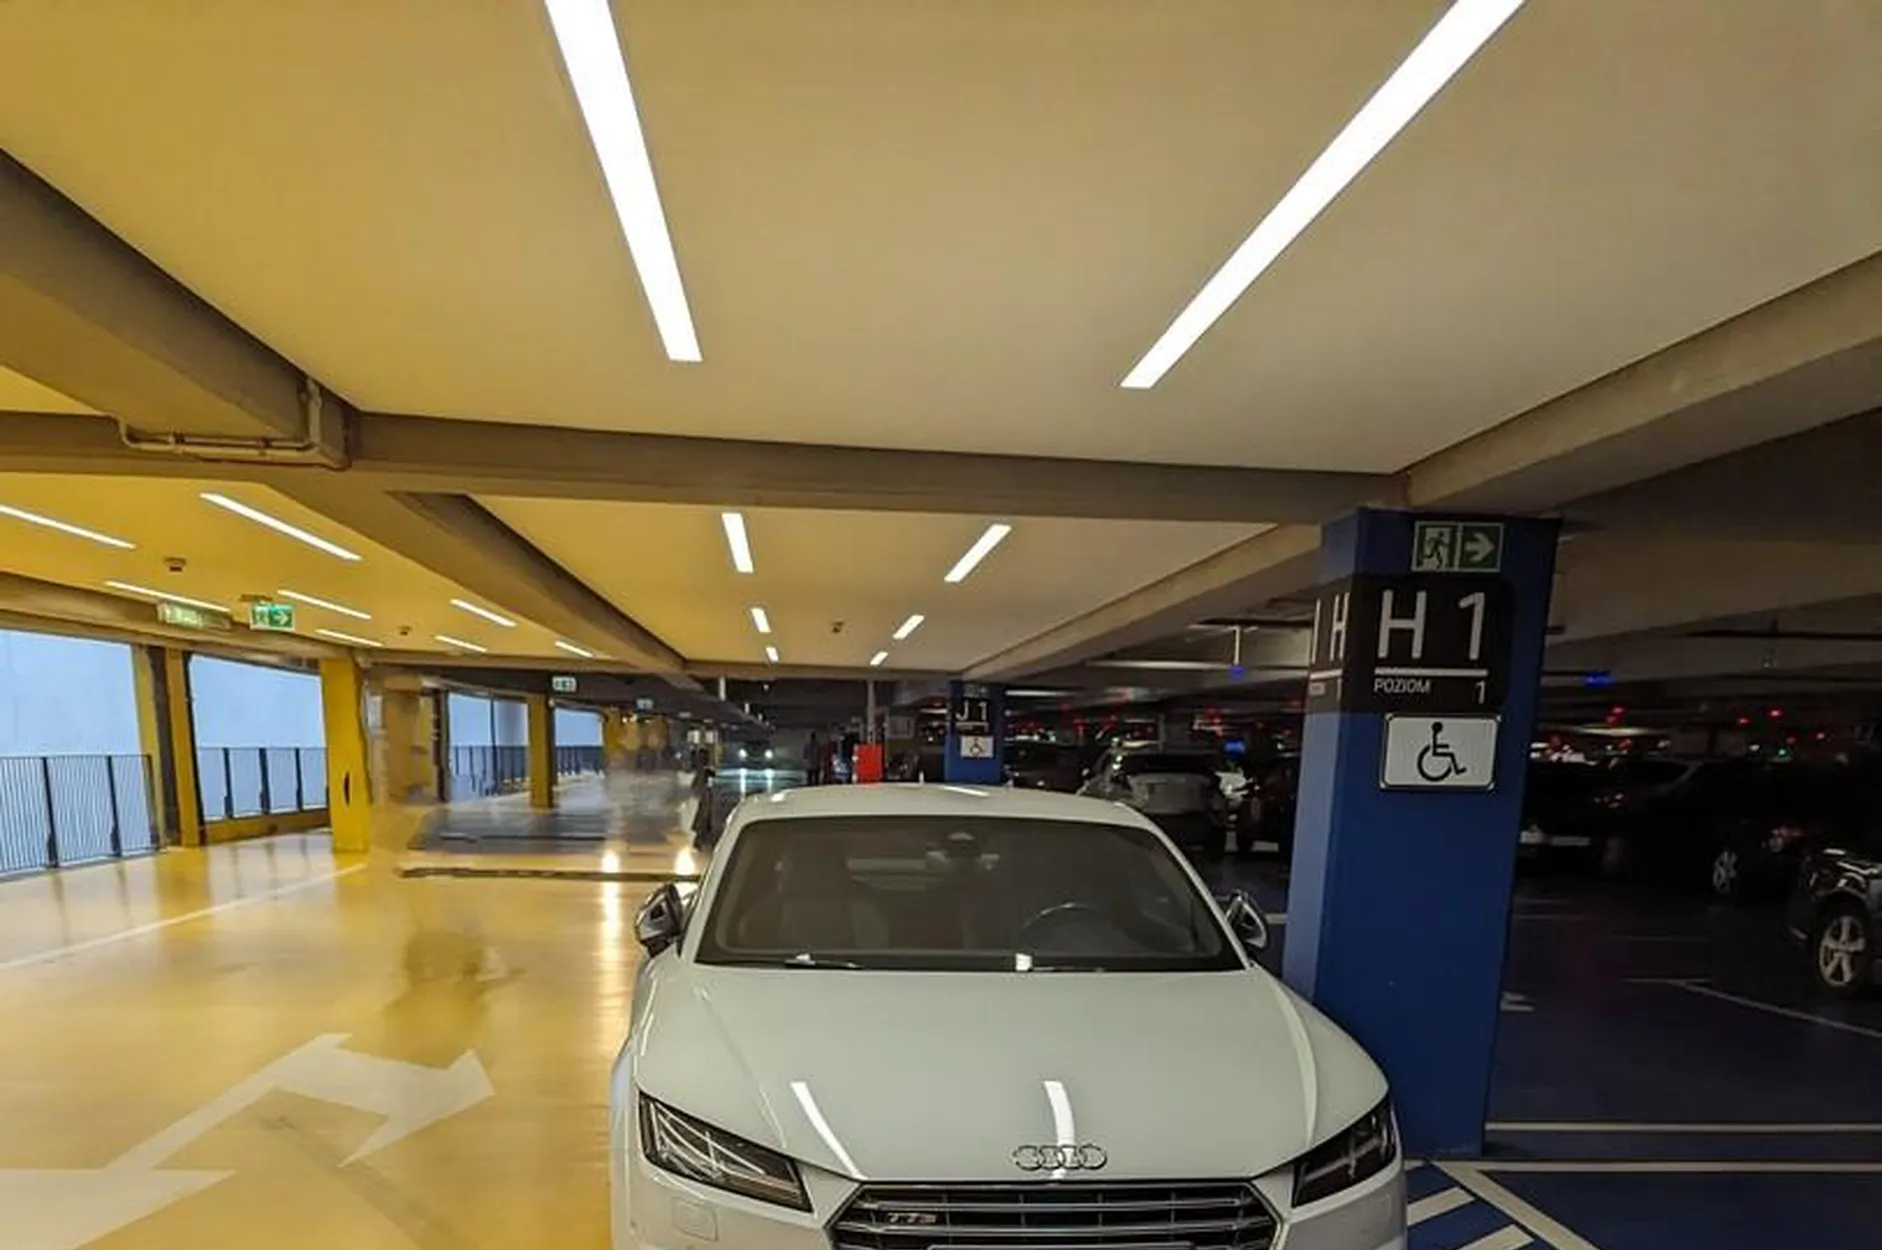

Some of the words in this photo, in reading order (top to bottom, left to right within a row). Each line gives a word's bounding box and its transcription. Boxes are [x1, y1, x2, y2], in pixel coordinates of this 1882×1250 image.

[1330, 593, 1350, 661] H
[1376, 588, 1427, 660] H
[1457, 591, 1487, 661] 1
[955, 700, 970, 721] J
[978, 701, 988, 721] 1
[1373, 679, 1431, 694] POZIOM
[1475, 680, 1487, 705] 1
